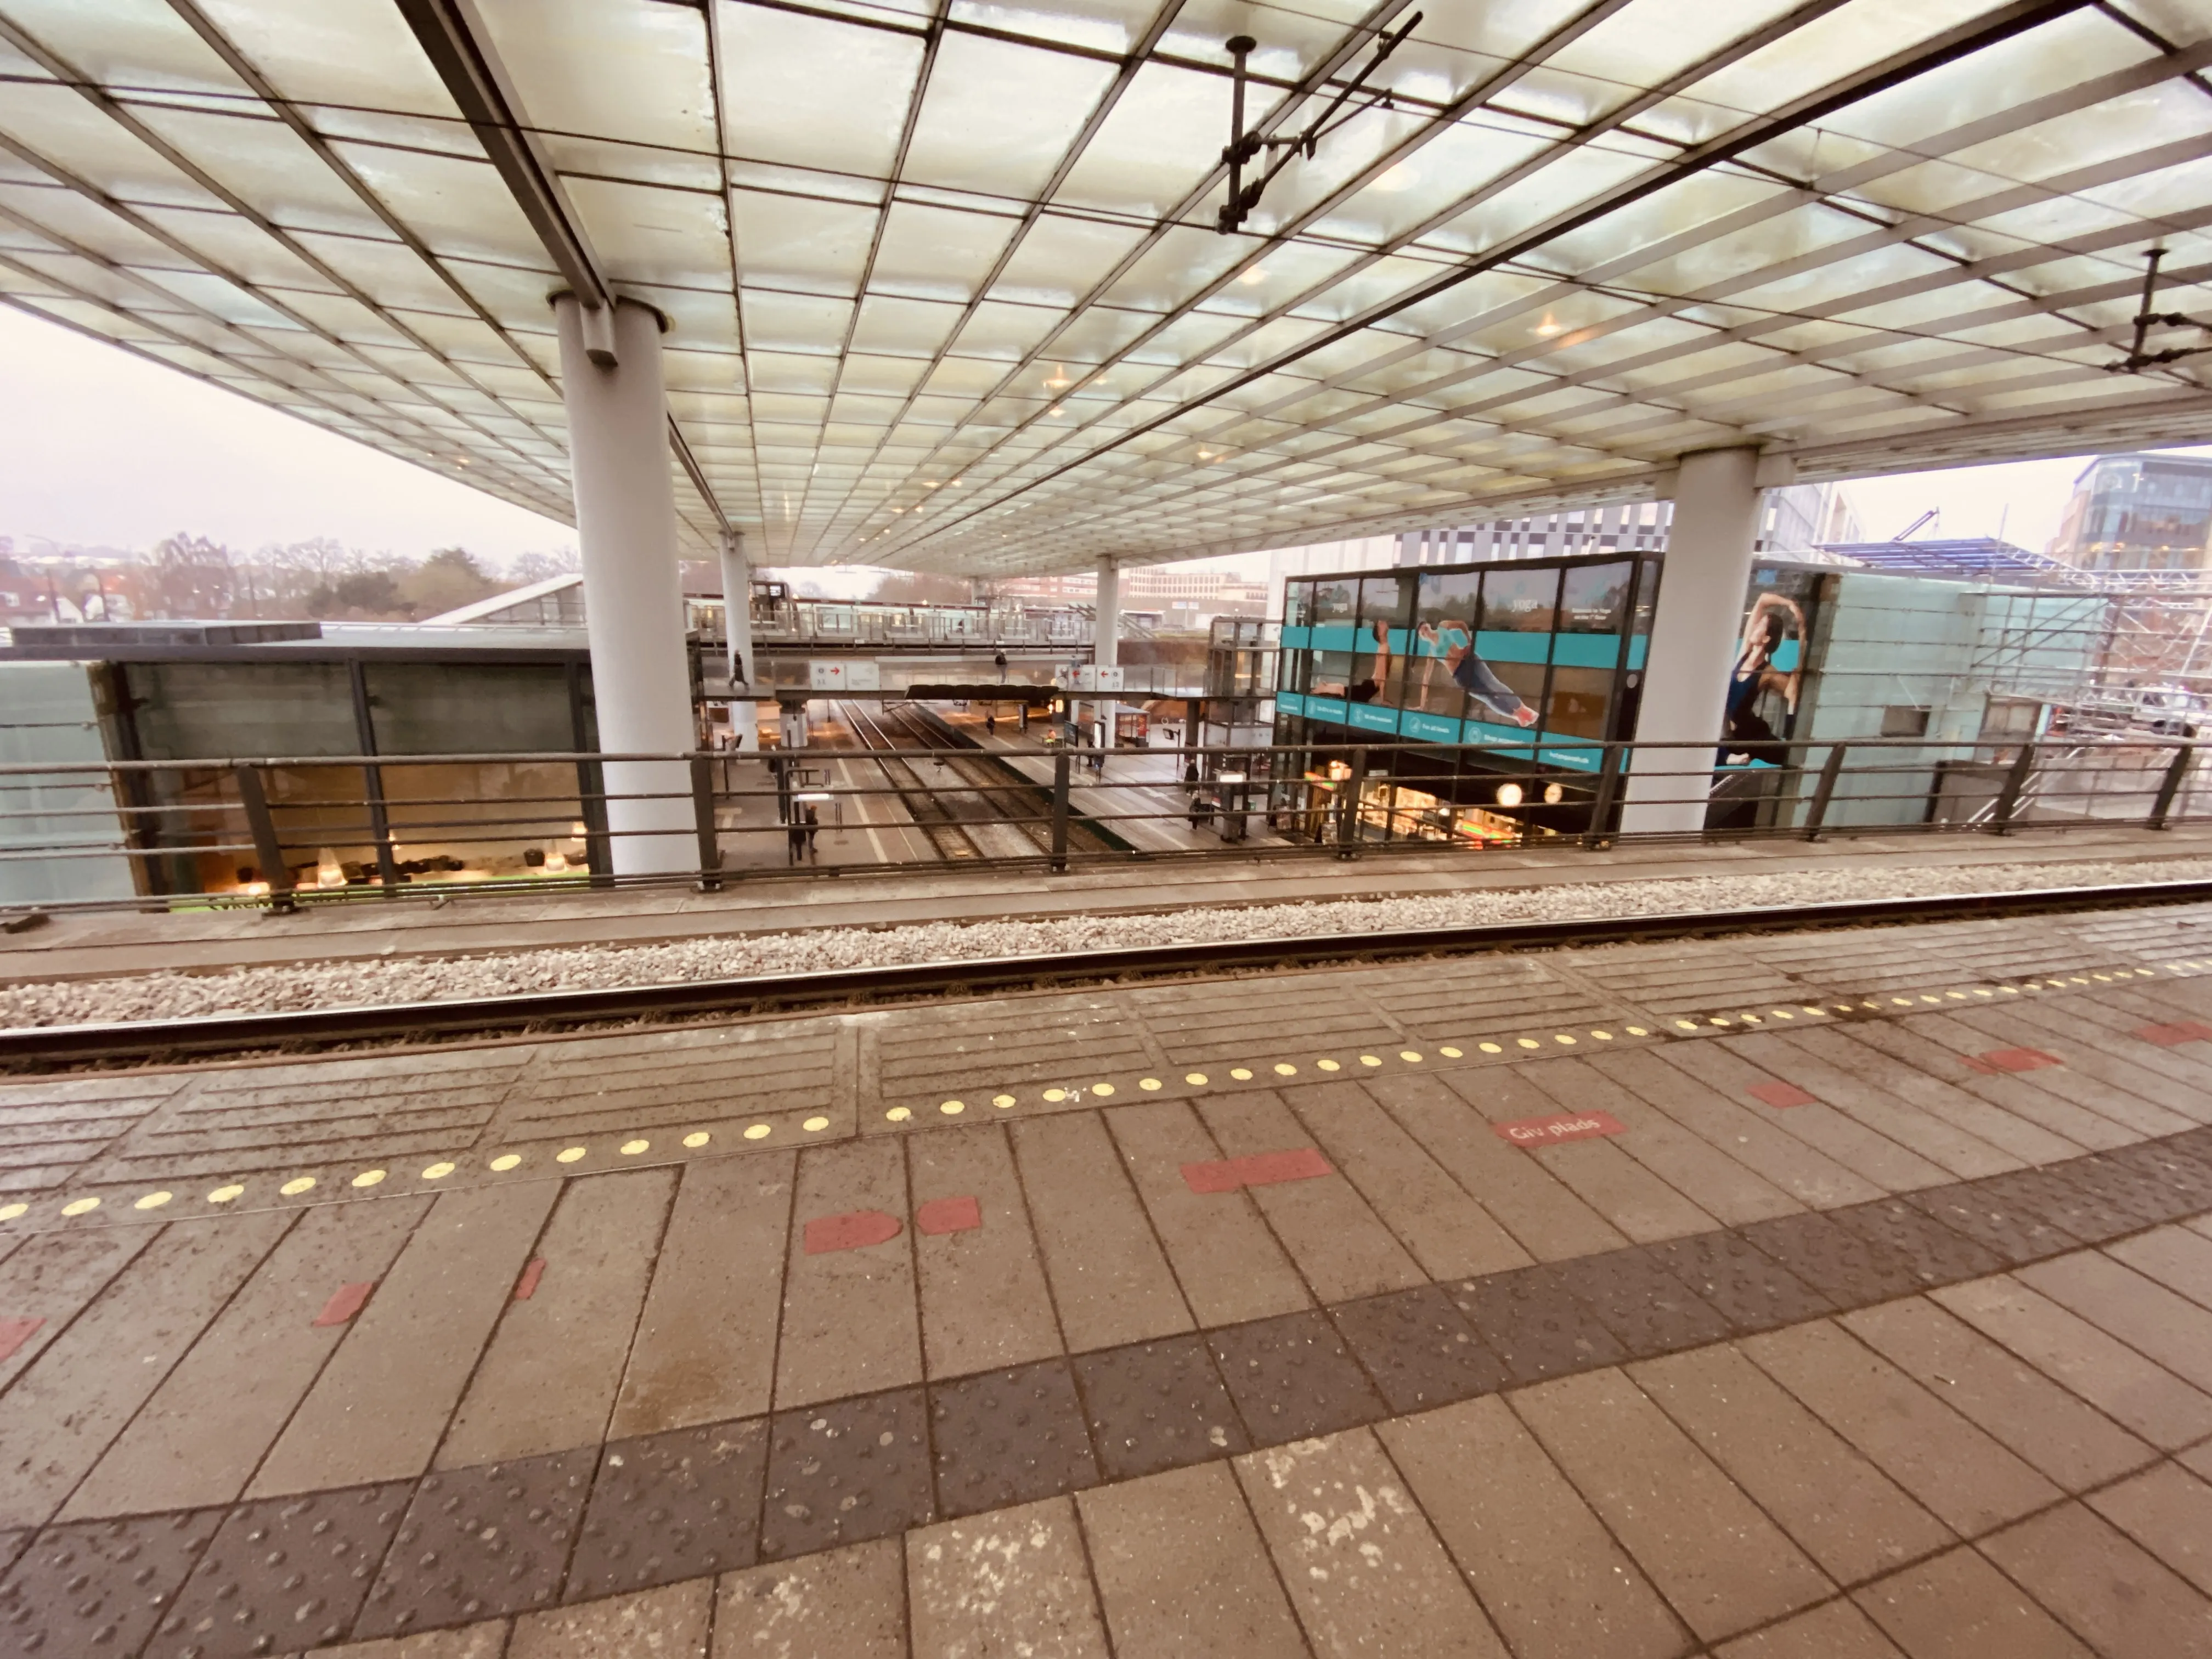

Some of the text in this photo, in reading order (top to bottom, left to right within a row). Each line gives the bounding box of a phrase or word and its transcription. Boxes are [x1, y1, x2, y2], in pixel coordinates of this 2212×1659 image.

[1511, 599, 1538, 612] yoga
[1509, 1118, 1600, 1139] Giv plads
